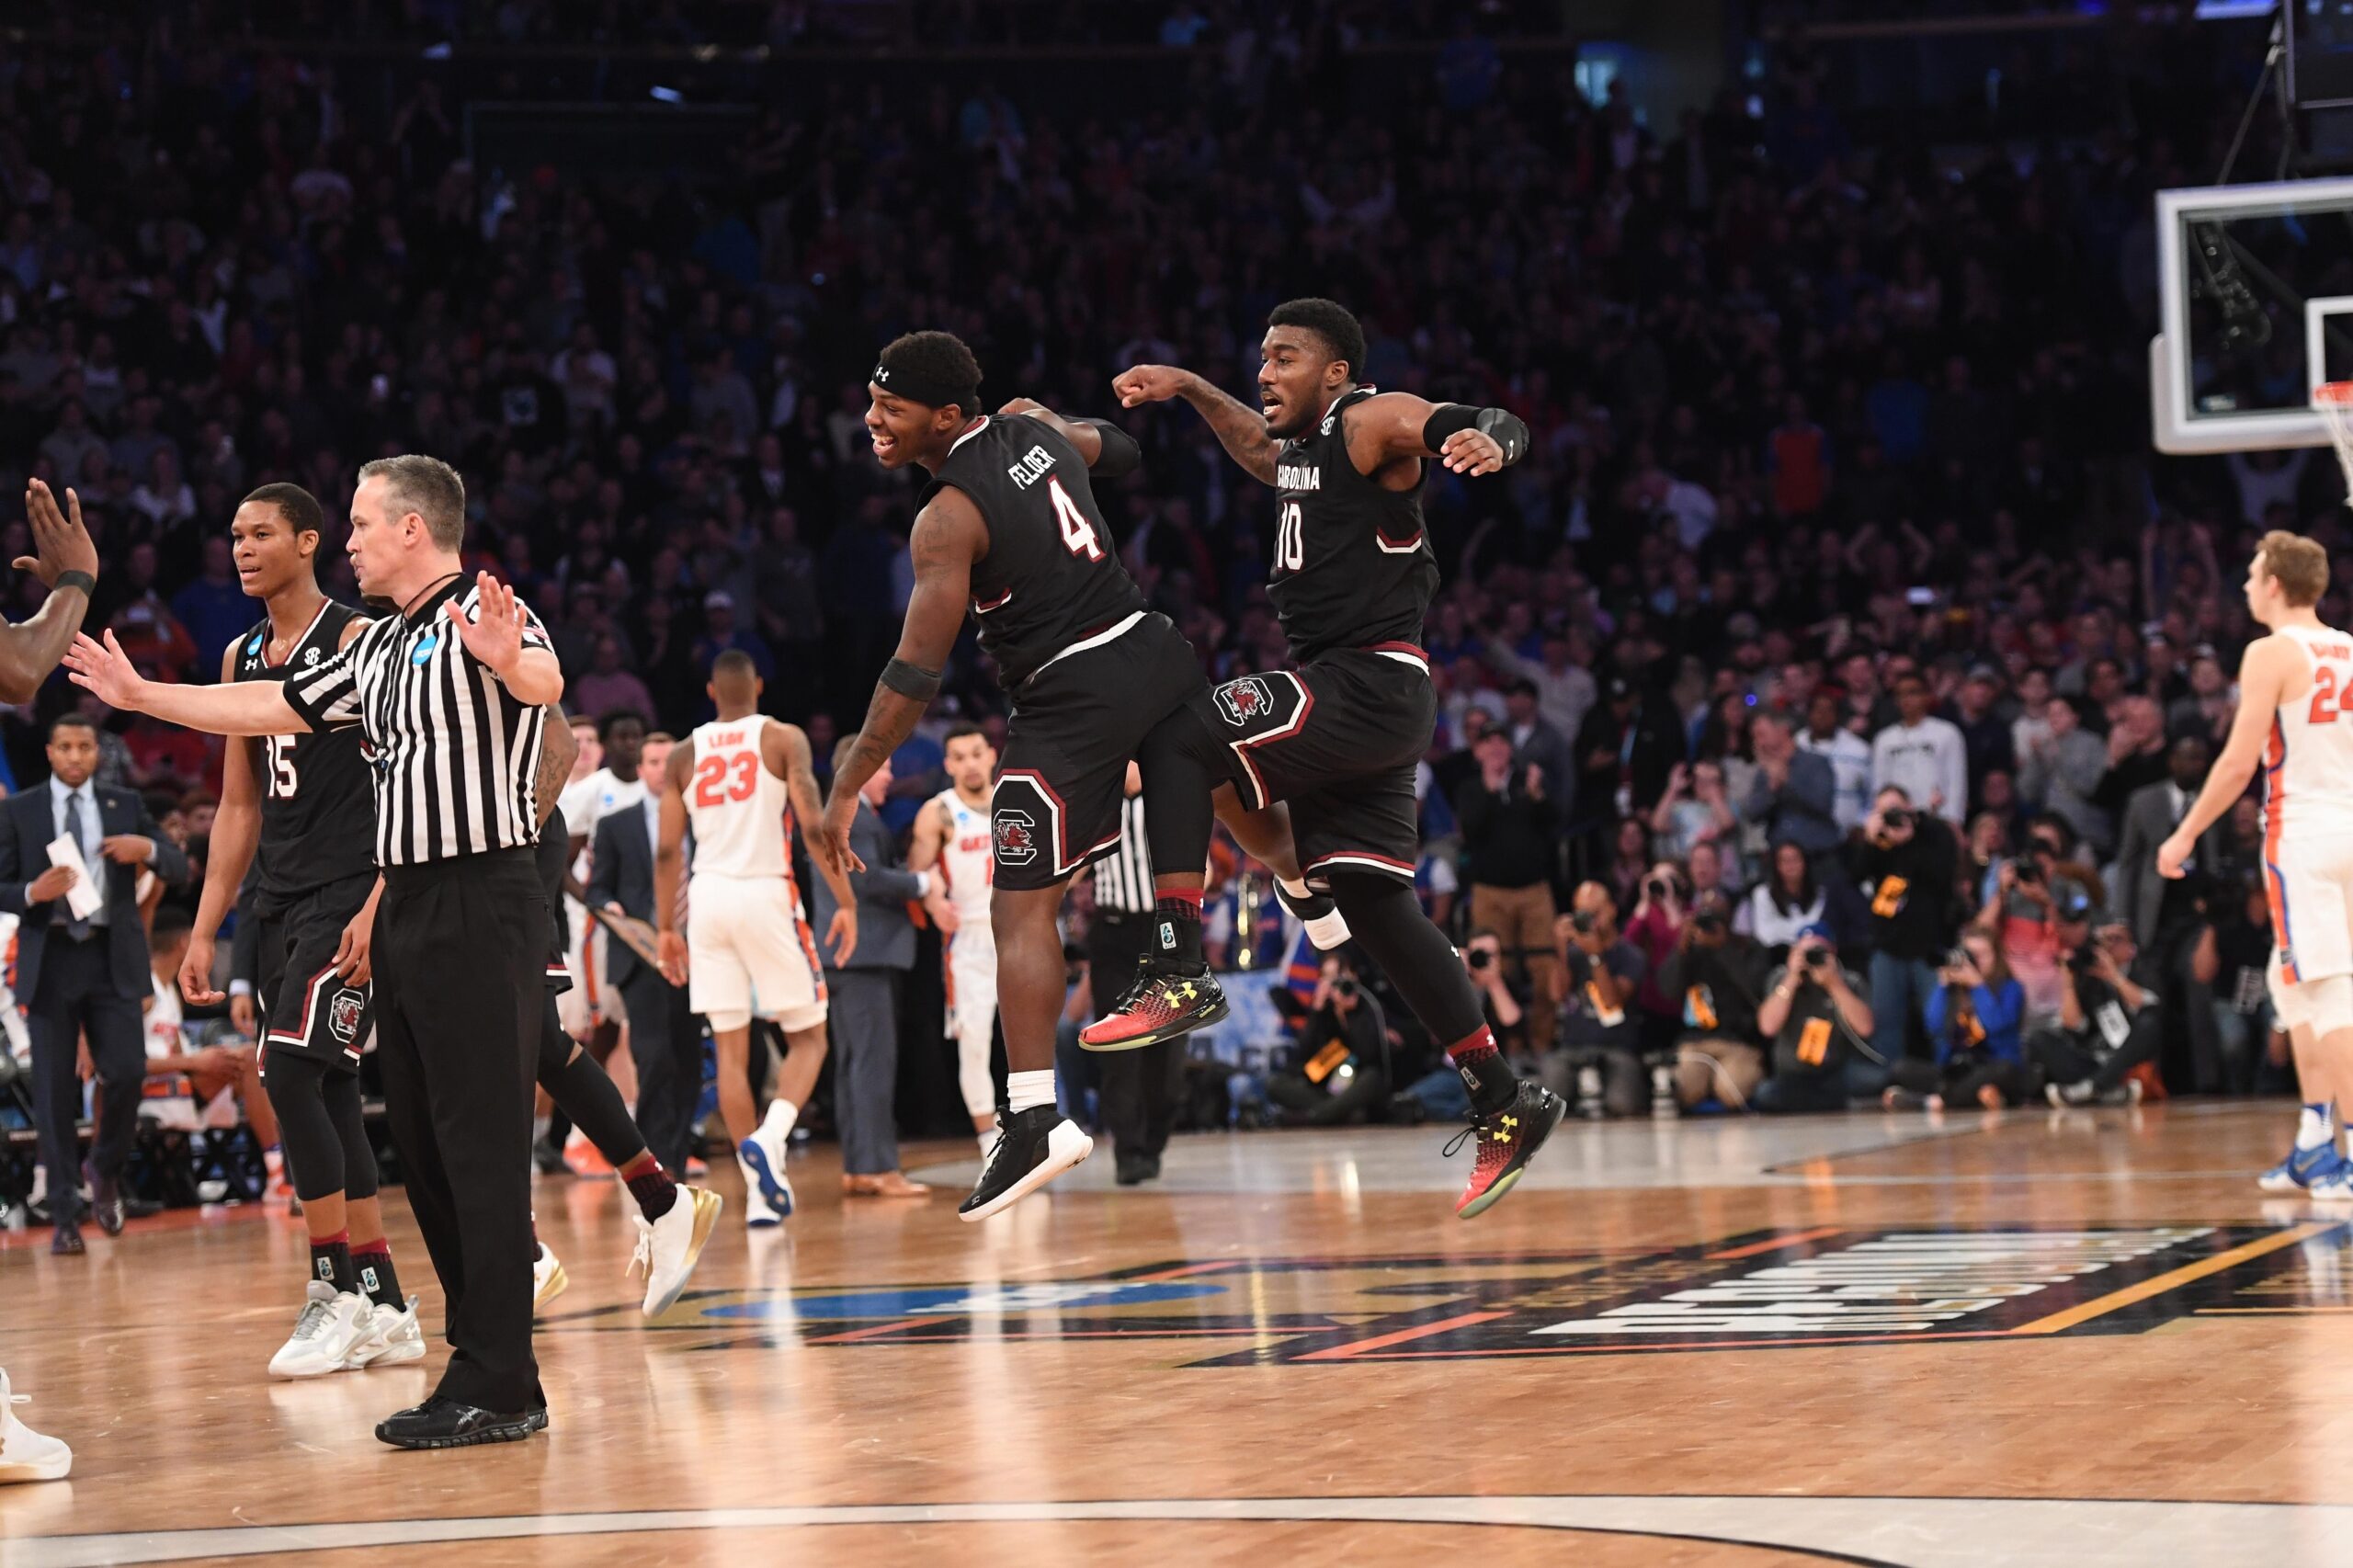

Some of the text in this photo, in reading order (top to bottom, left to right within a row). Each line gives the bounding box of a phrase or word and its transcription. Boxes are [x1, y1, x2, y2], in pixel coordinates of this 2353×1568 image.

[1007, 445, 1057, 491] FELDER
[1277, 464, 1321, 491] CAROLINA
[1047, 472, 1107, 563] 4
[1276, 500, 1304, 574] 10
[267, 734, 298, 799] 15
[697, 750, 758, 808] 23
